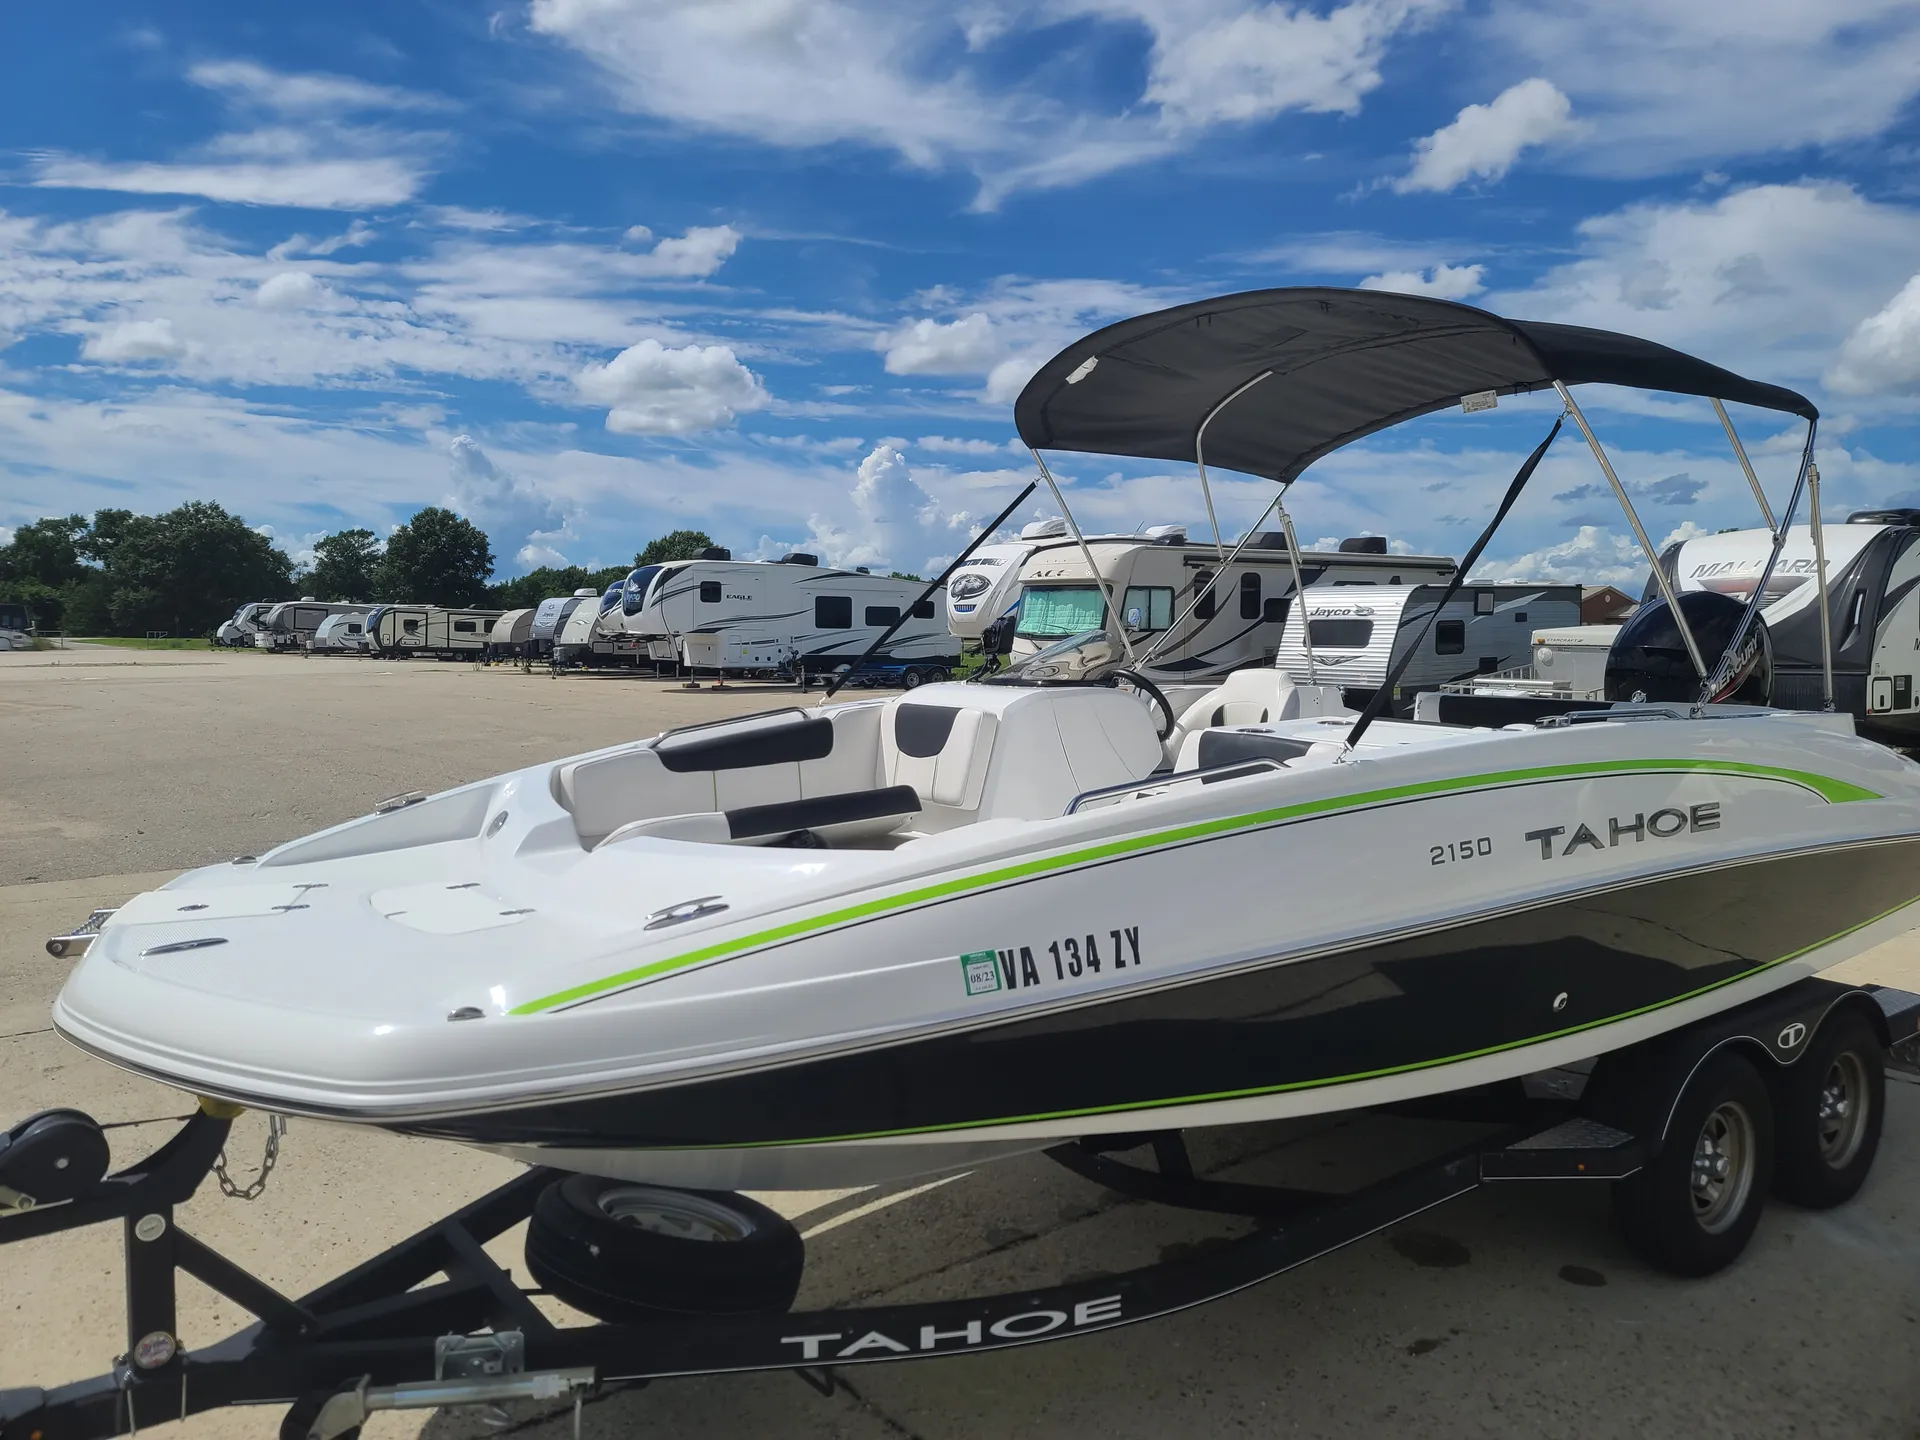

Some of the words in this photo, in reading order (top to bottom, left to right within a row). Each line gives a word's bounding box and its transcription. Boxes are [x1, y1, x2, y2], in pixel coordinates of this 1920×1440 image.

[1310, 607, 1351, 618] Jayco
[1710, 629, 1760, 697] MERCURY
[1429, 836, 1493, 866] 2150
[1524, 801, 1721, 861] TAHOE
[970, 970, 995, 984] 08/23
[998, 945, 1041, 990] VA
[1048, 933, 1101, 981] 134
[1109, 925, 1142, 970] ZY
[780, 1293, 1122, 1360] TAHOE
